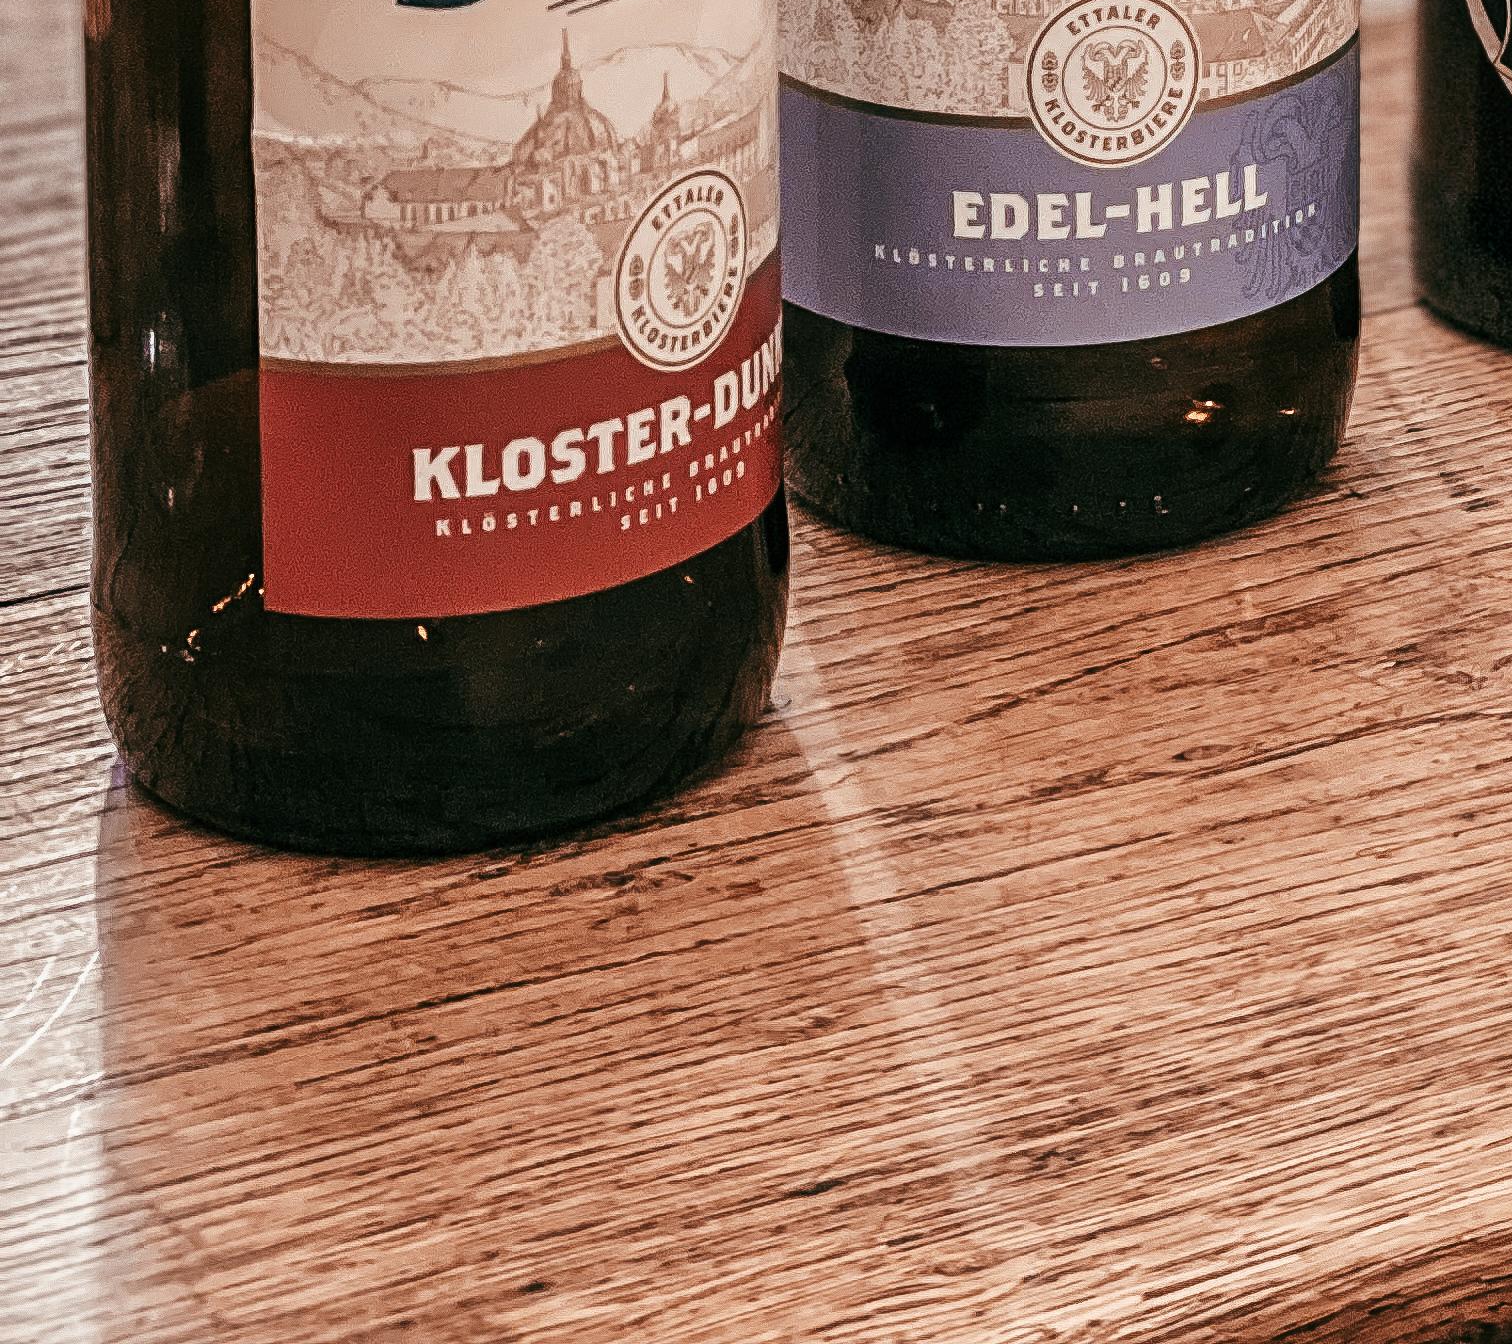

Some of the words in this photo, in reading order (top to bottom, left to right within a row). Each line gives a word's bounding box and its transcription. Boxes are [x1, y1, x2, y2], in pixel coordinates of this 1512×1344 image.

[1066, 5, 1161, 36] ETTALER
[1044, 87, 1184, 152] KLOSTERBIERE
[951, 163, 1269, 241] EDEL-HELL
[874, 243, 1090, 273] KLÖSTERLICHE
[1113, 202, 1317, 270] BRAUTRADITION
[1033, 280, 1099, 298] SEIT
[1121, 268, 1192, 293] 1609
[436, 472, 672, 537] KLÖSTERLICHE
[620, 495, 678, 532] SEIT
